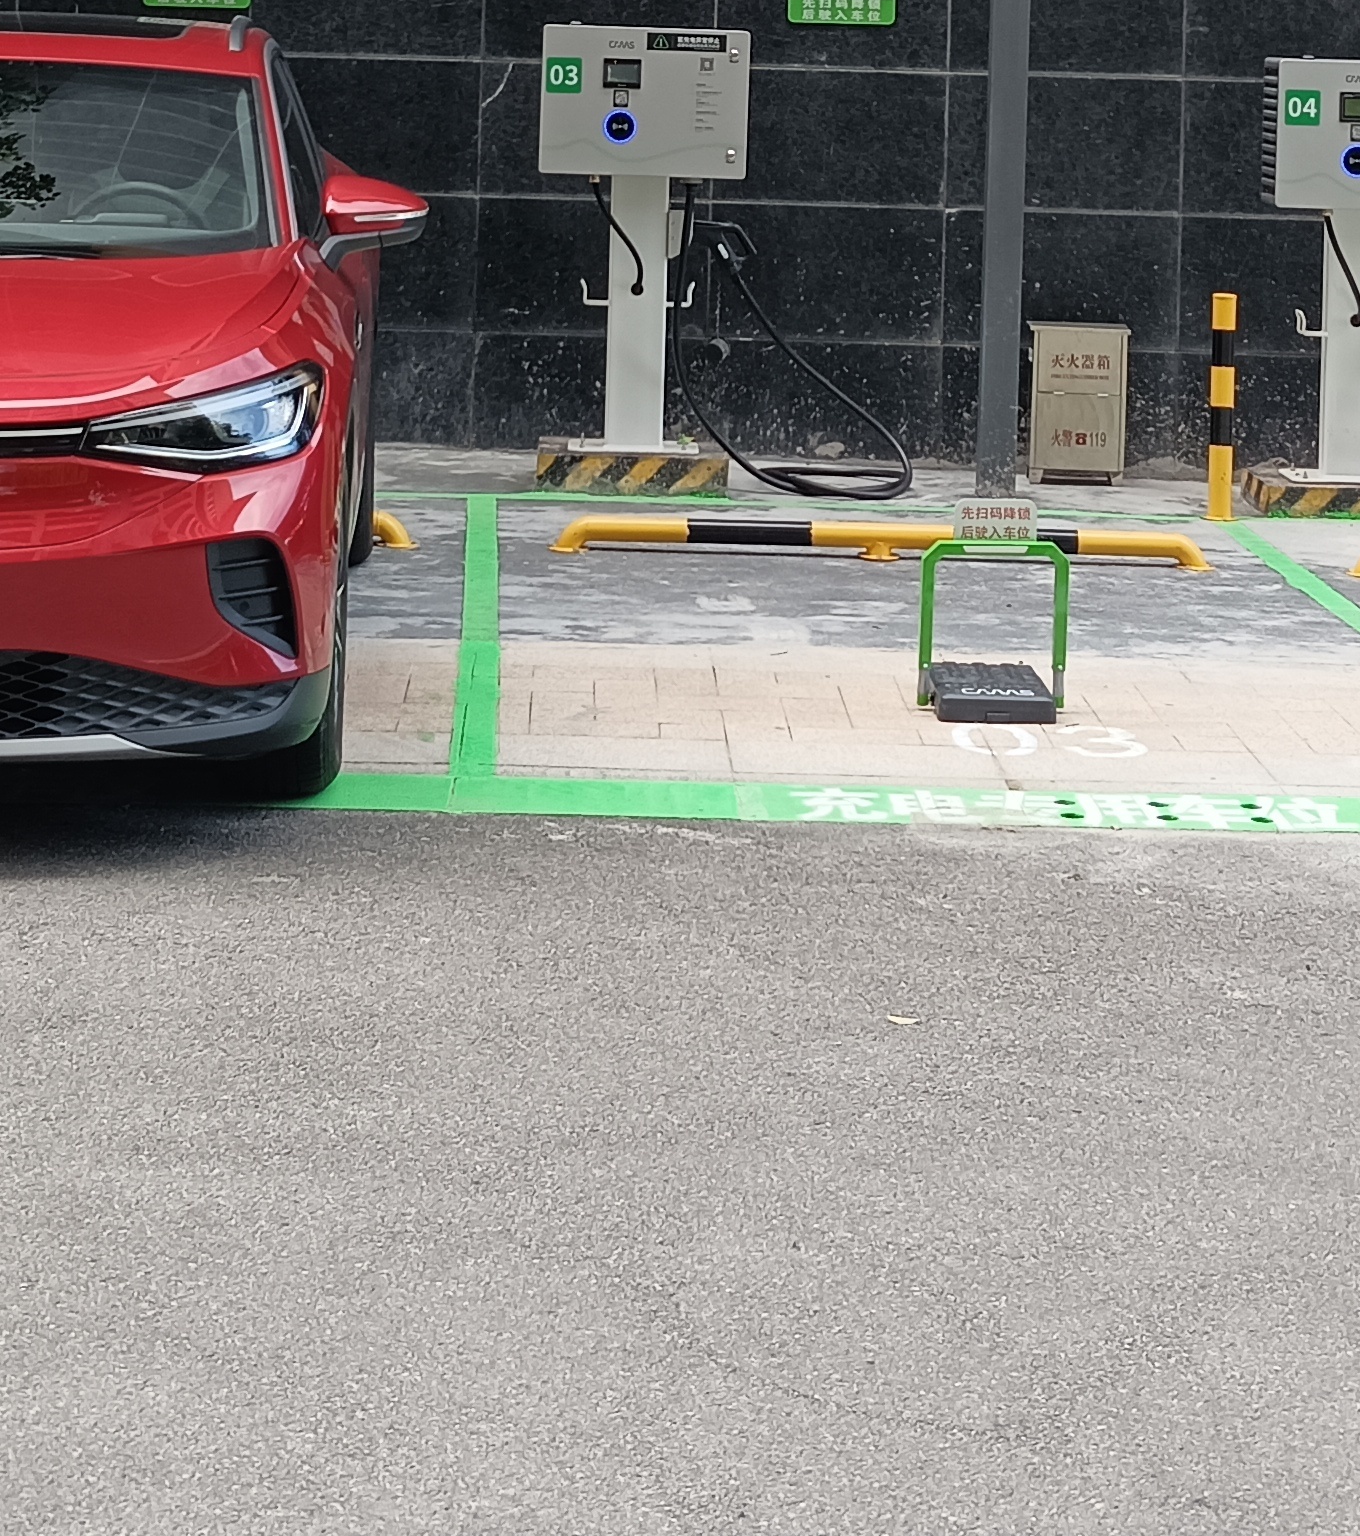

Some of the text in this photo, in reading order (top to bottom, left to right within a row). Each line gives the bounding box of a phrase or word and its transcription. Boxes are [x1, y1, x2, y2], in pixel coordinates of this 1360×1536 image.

[802, 9, 881, 21] 后驶入车位
[549, 64, 578, 85] 03
[1288, 97, 1317, 118] 04
[1051, 353, 1110, 370] 灭火器箱
[1051, 429, 1107, 447] 火警 119
[961, 506, 1031, 520] 先扫码降锁
[961, 525, 1031, 540] 后驶入车位
[950, 722, 1148, 759] 03
